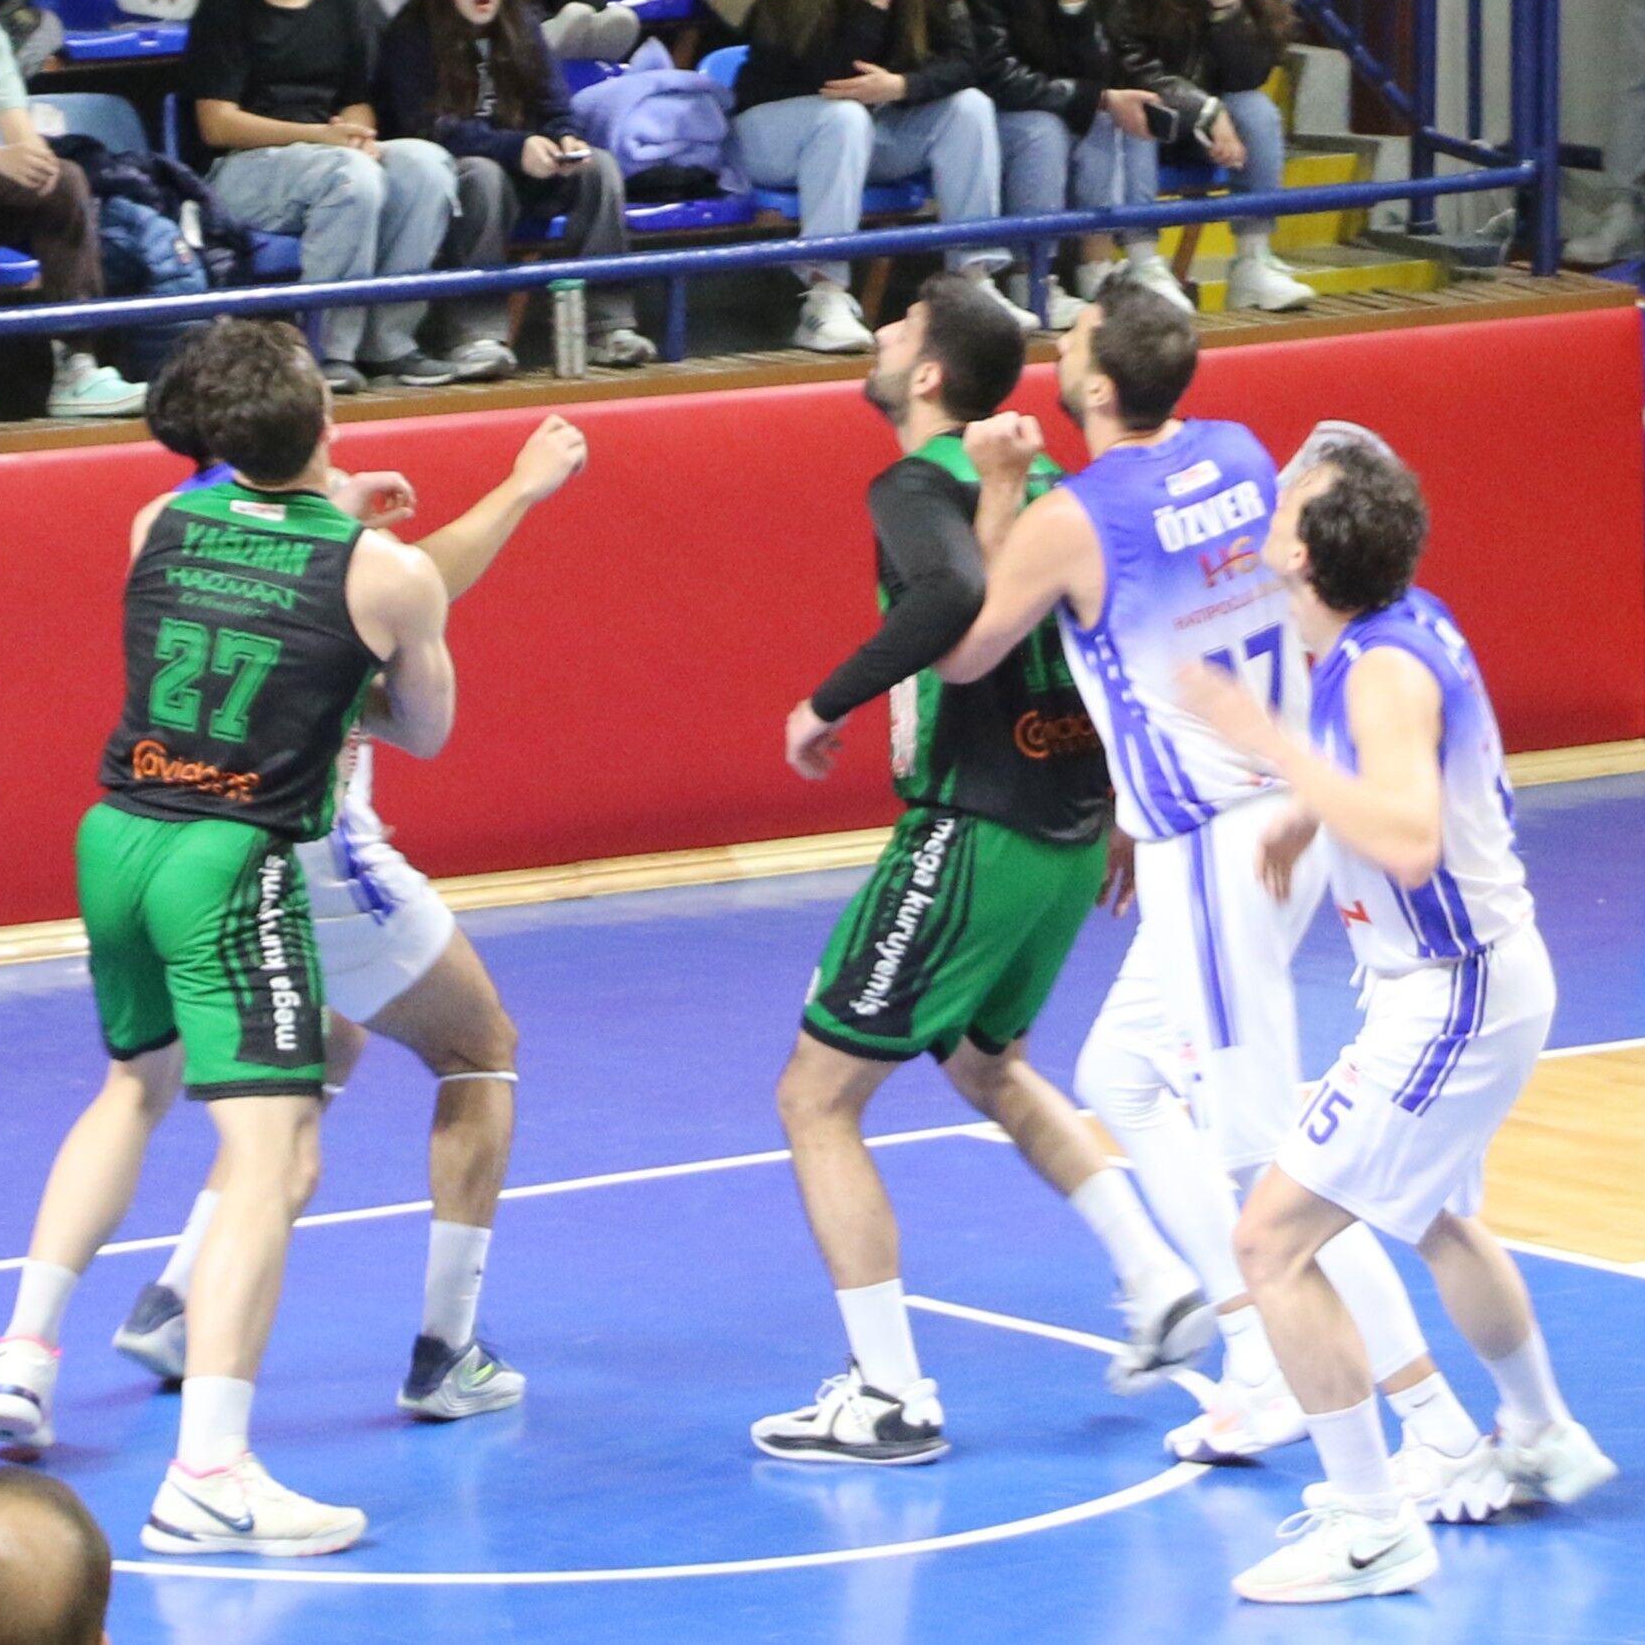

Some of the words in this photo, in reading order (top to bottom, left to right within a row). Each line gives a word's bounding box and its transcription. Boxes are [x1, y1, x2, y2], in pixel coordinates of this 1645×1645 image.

[1152, 480, 1267, 553] ÖZVER
[148, 616, 284, 744] 27
[911, 817, 956, 888] mega
[269, 974, 303, 1052] mega
[1298, 1079, 1354, 1146] 15
